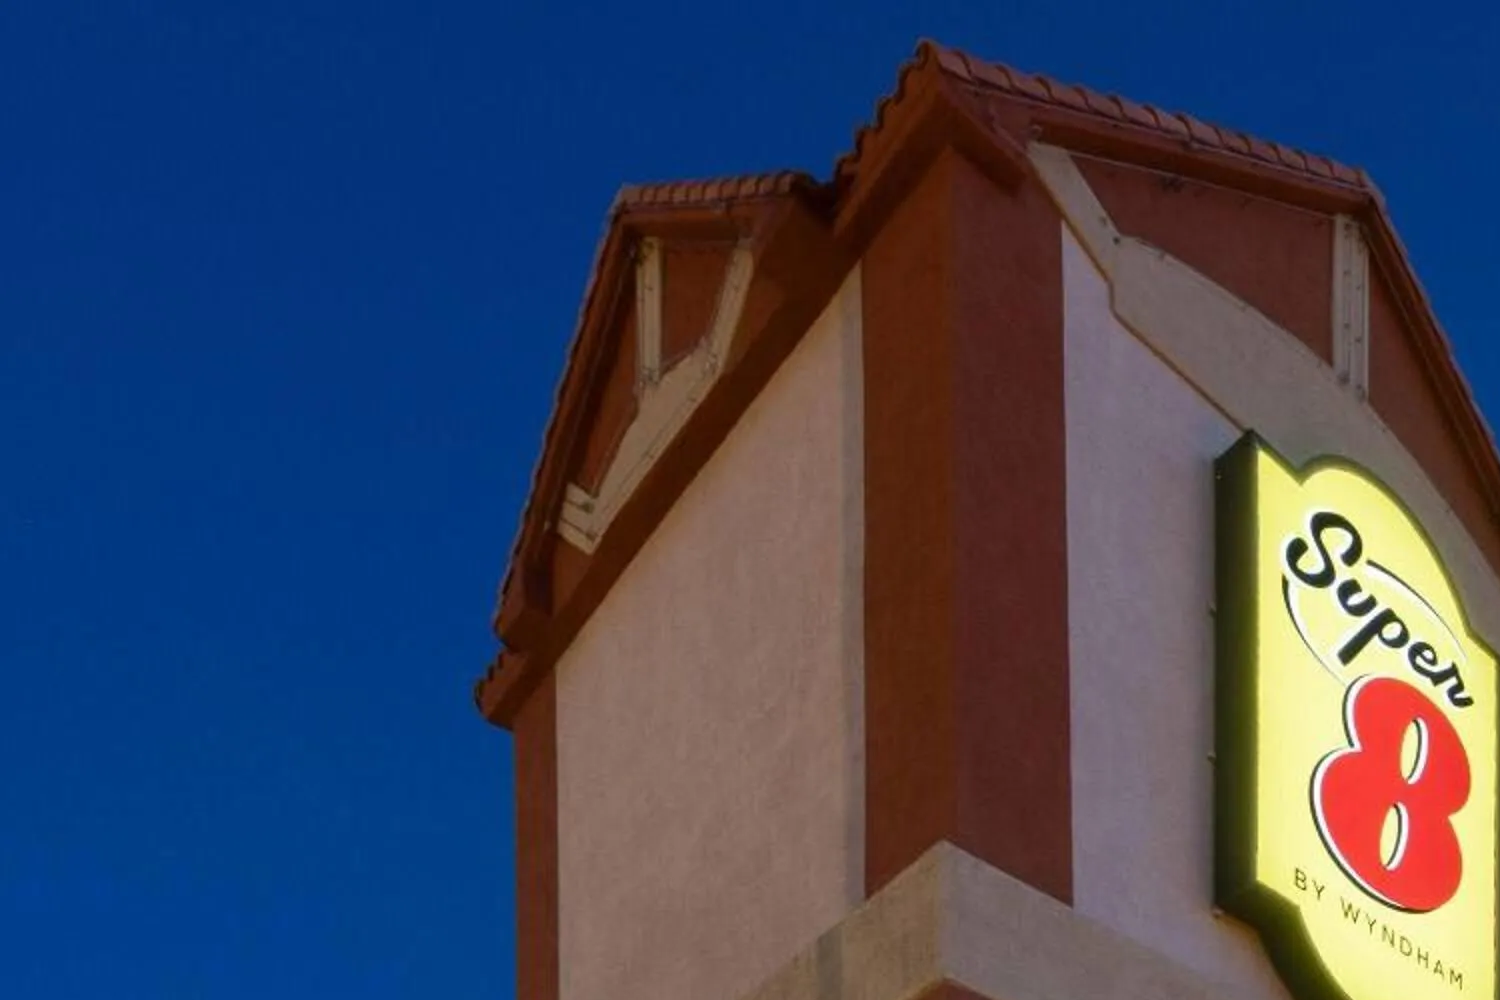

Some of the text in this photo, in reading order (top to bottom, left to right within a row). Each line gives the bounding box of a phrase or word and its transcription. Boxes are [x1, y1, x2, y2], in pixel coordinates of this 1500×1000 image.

[1285, 511, 1474, 708] Super
[1309, 675, 1471, 914] 8
[1294, 867, 1464, 991] BY WYNDHAM
